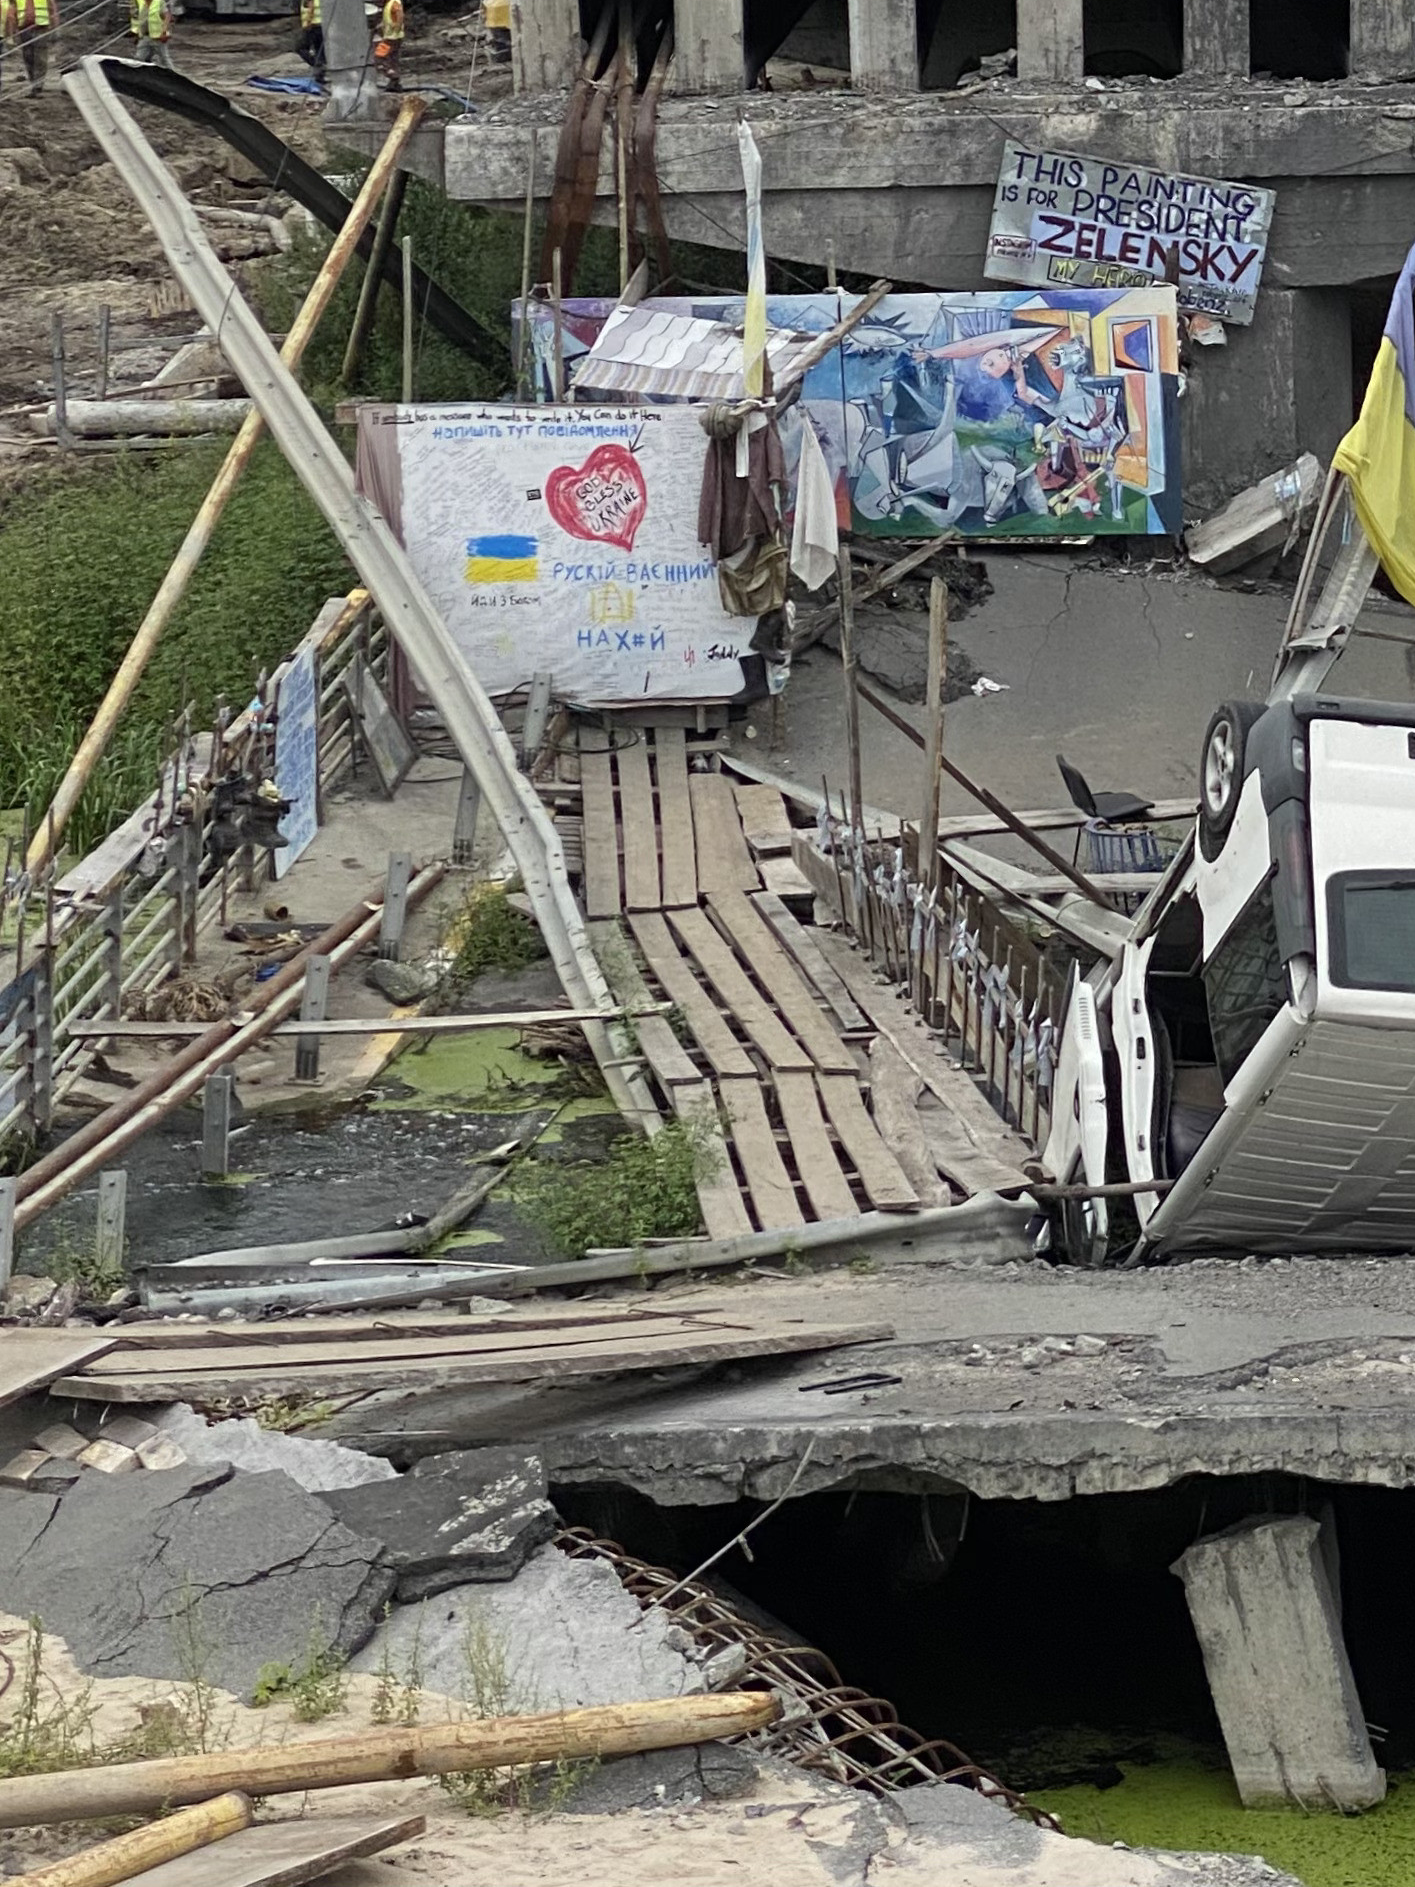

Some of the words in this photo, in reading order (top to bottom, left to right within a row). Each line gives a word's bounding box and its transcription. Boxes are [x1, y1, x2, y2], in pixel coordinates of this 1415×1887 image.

[1013, 151, 1084, 188] THIS
[1101, 166, 1256, 216] PAINTING
[1001, 185, 1019, 202] IS
[1026, 187, 1058, 209] FOR
[1072, 189, 1250, 243] PRESIDENT
[1038, 214, 1259, 283] ZELENSKY
[1053, 260, 1080, 280] MY
[1091, 264, 1147, 288] HERO
[575, 409, 591, 421] You
[614, 409, 627, 421] do
[576, 476, 601, 499] GOD
[584, 480, 622, 511] BLESS
[590, 487, 639, 532] UKRAINE
[552, 560, 616, 582] РУСКІЙ
[627, 557, 715, 583] ВАЄННИЙ
[576, 624, 665, 651] НАХ#Й
